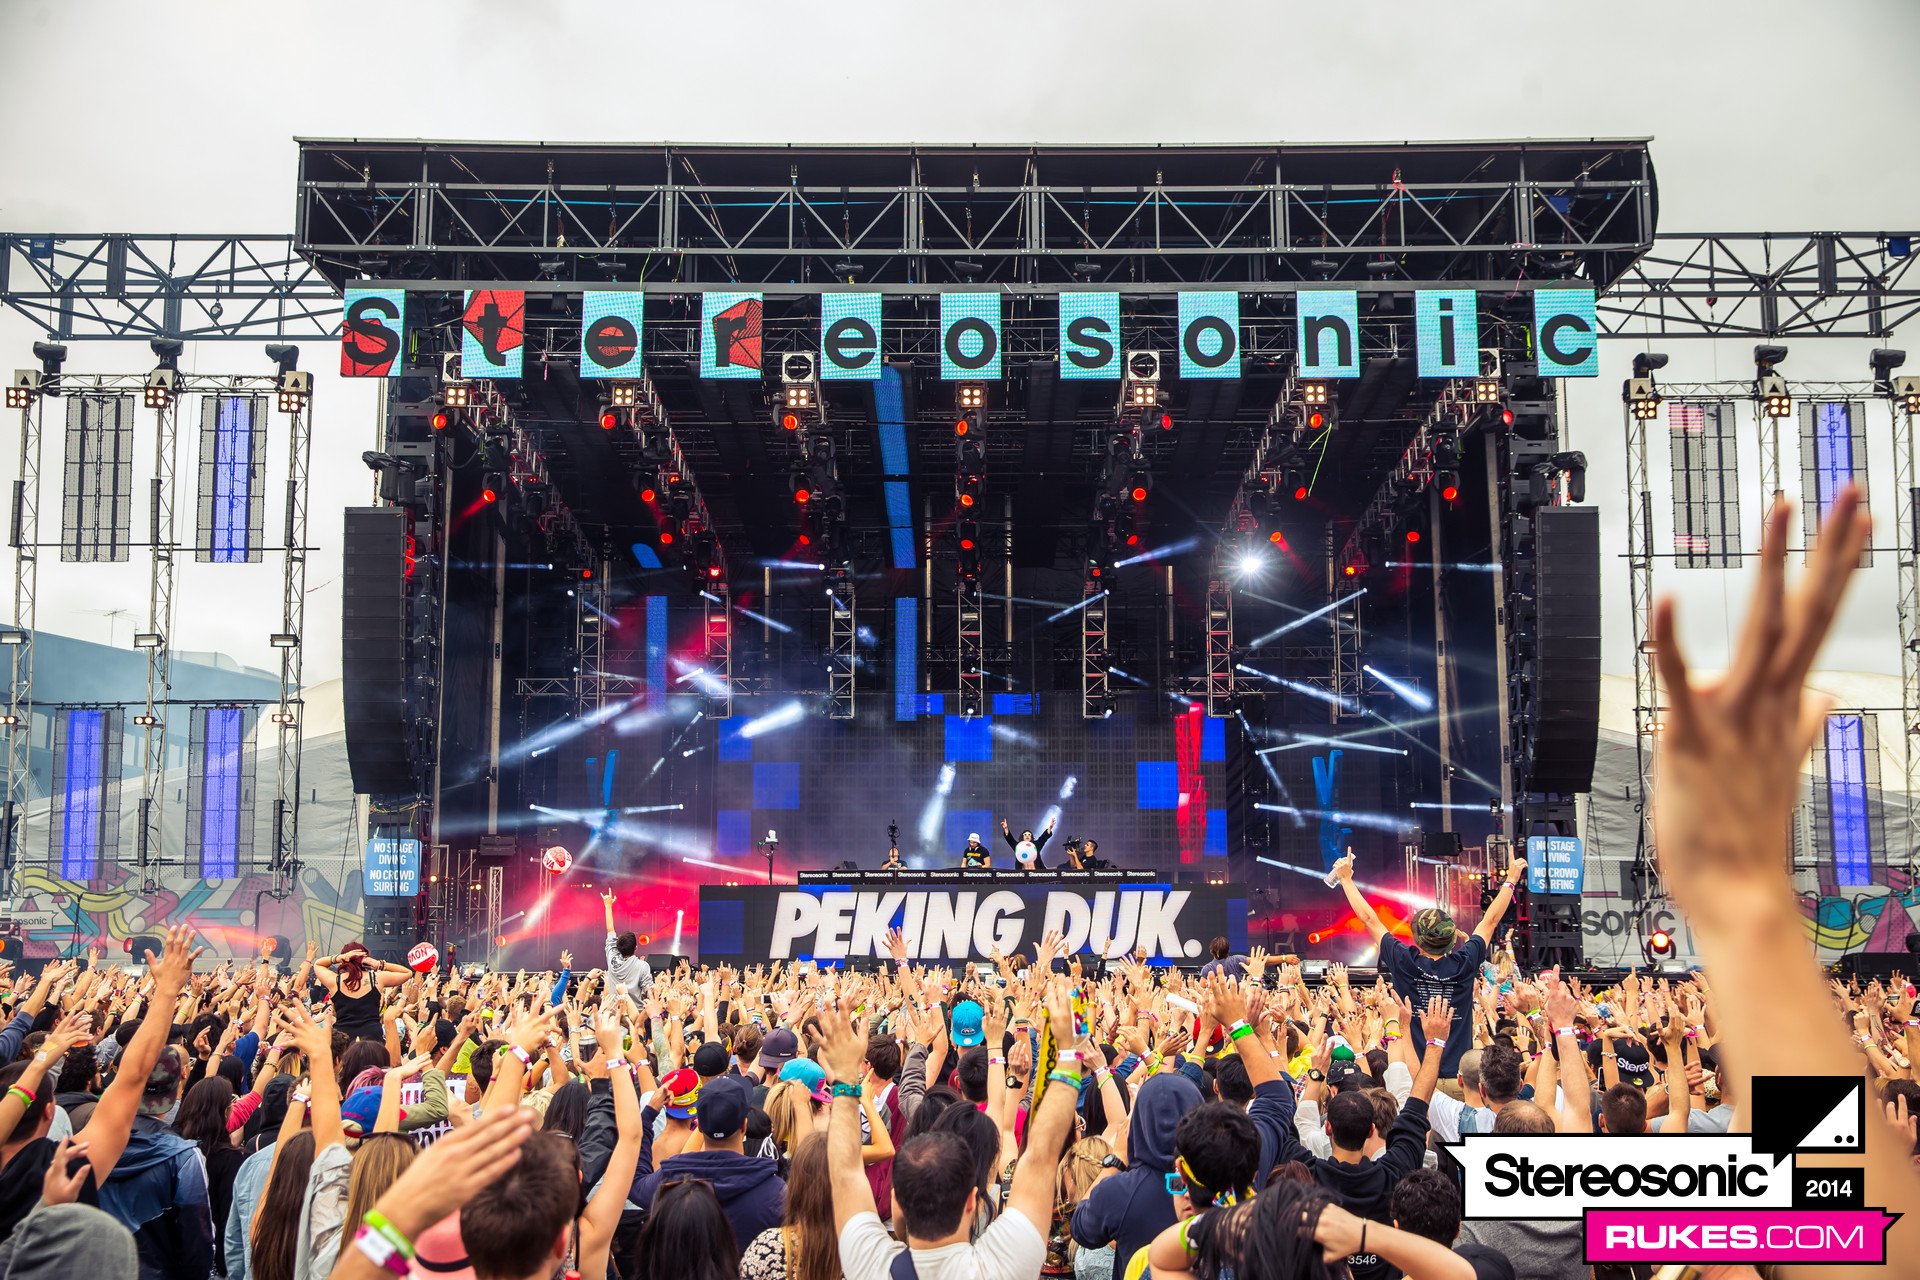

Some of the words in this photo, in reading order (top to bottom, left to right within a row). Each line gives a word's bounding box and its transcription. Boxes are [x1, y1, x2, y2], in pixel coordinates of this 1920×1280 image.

[374, 843, 385, 853] NO
[387, 843, 413, 853] STAGE
[1551, 841, 1575, 852] STAGE
[370, 870, 383, 880] NO
[383, 870, 414, 880] CROWD
[1534, 867, 1546, 877] NO
[1549, 868, 1578, 879] CROWD
[769, 891, 1025, 959] PEKING
[1042, 890, 1202, 959] DUK.
